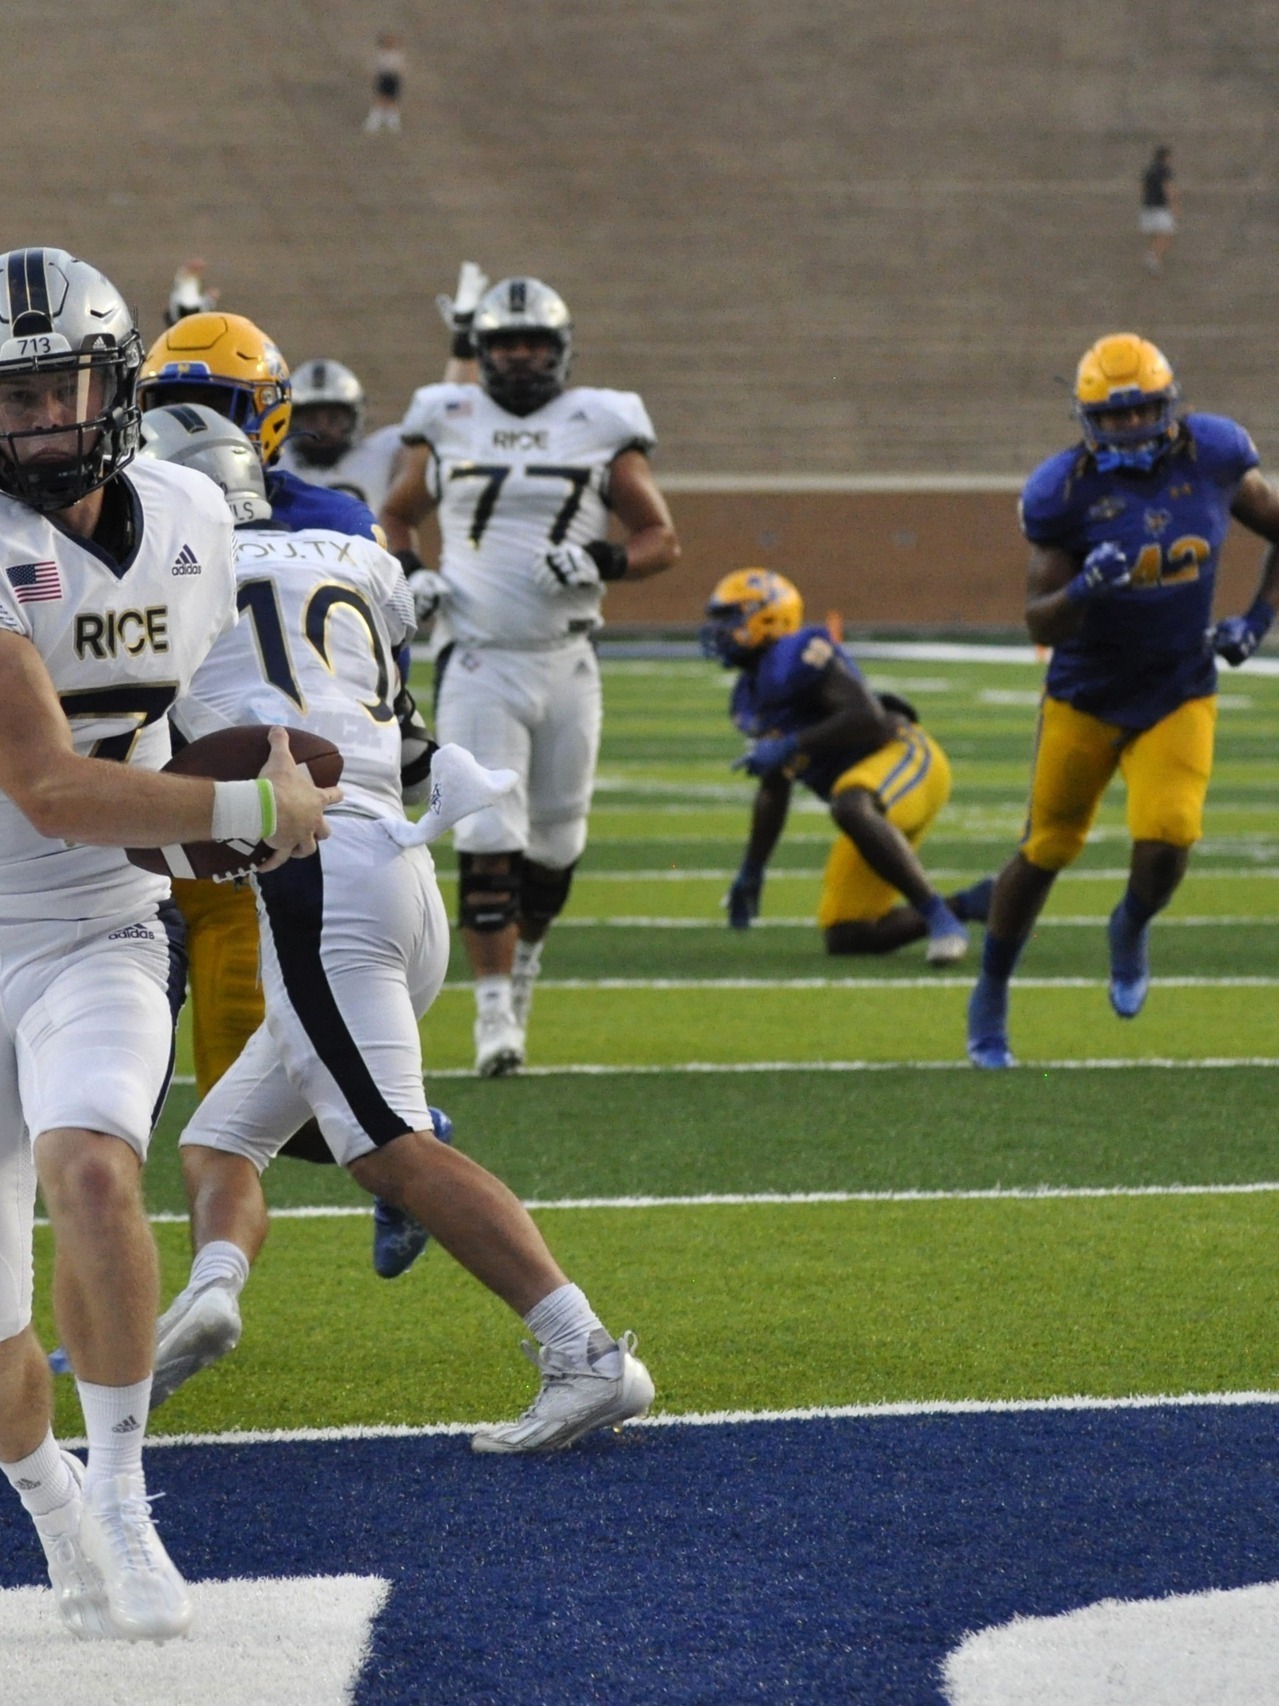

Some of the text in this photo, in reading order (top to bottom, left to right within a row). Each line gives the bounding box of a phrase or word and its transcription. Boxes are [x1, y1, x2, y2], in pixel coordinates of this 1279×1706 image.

[17, 337, 52, 356] 713
[229, 501, 255, 521] LS
[449, 464, 592, 548] 77
[171, 562, 202, 576] adidas
[73, 604, 169, 661] RICE
[235, 576, 398, 726] 10
[58, 679, 181, 764] 7
[108, 929, 155, 940] adidas
